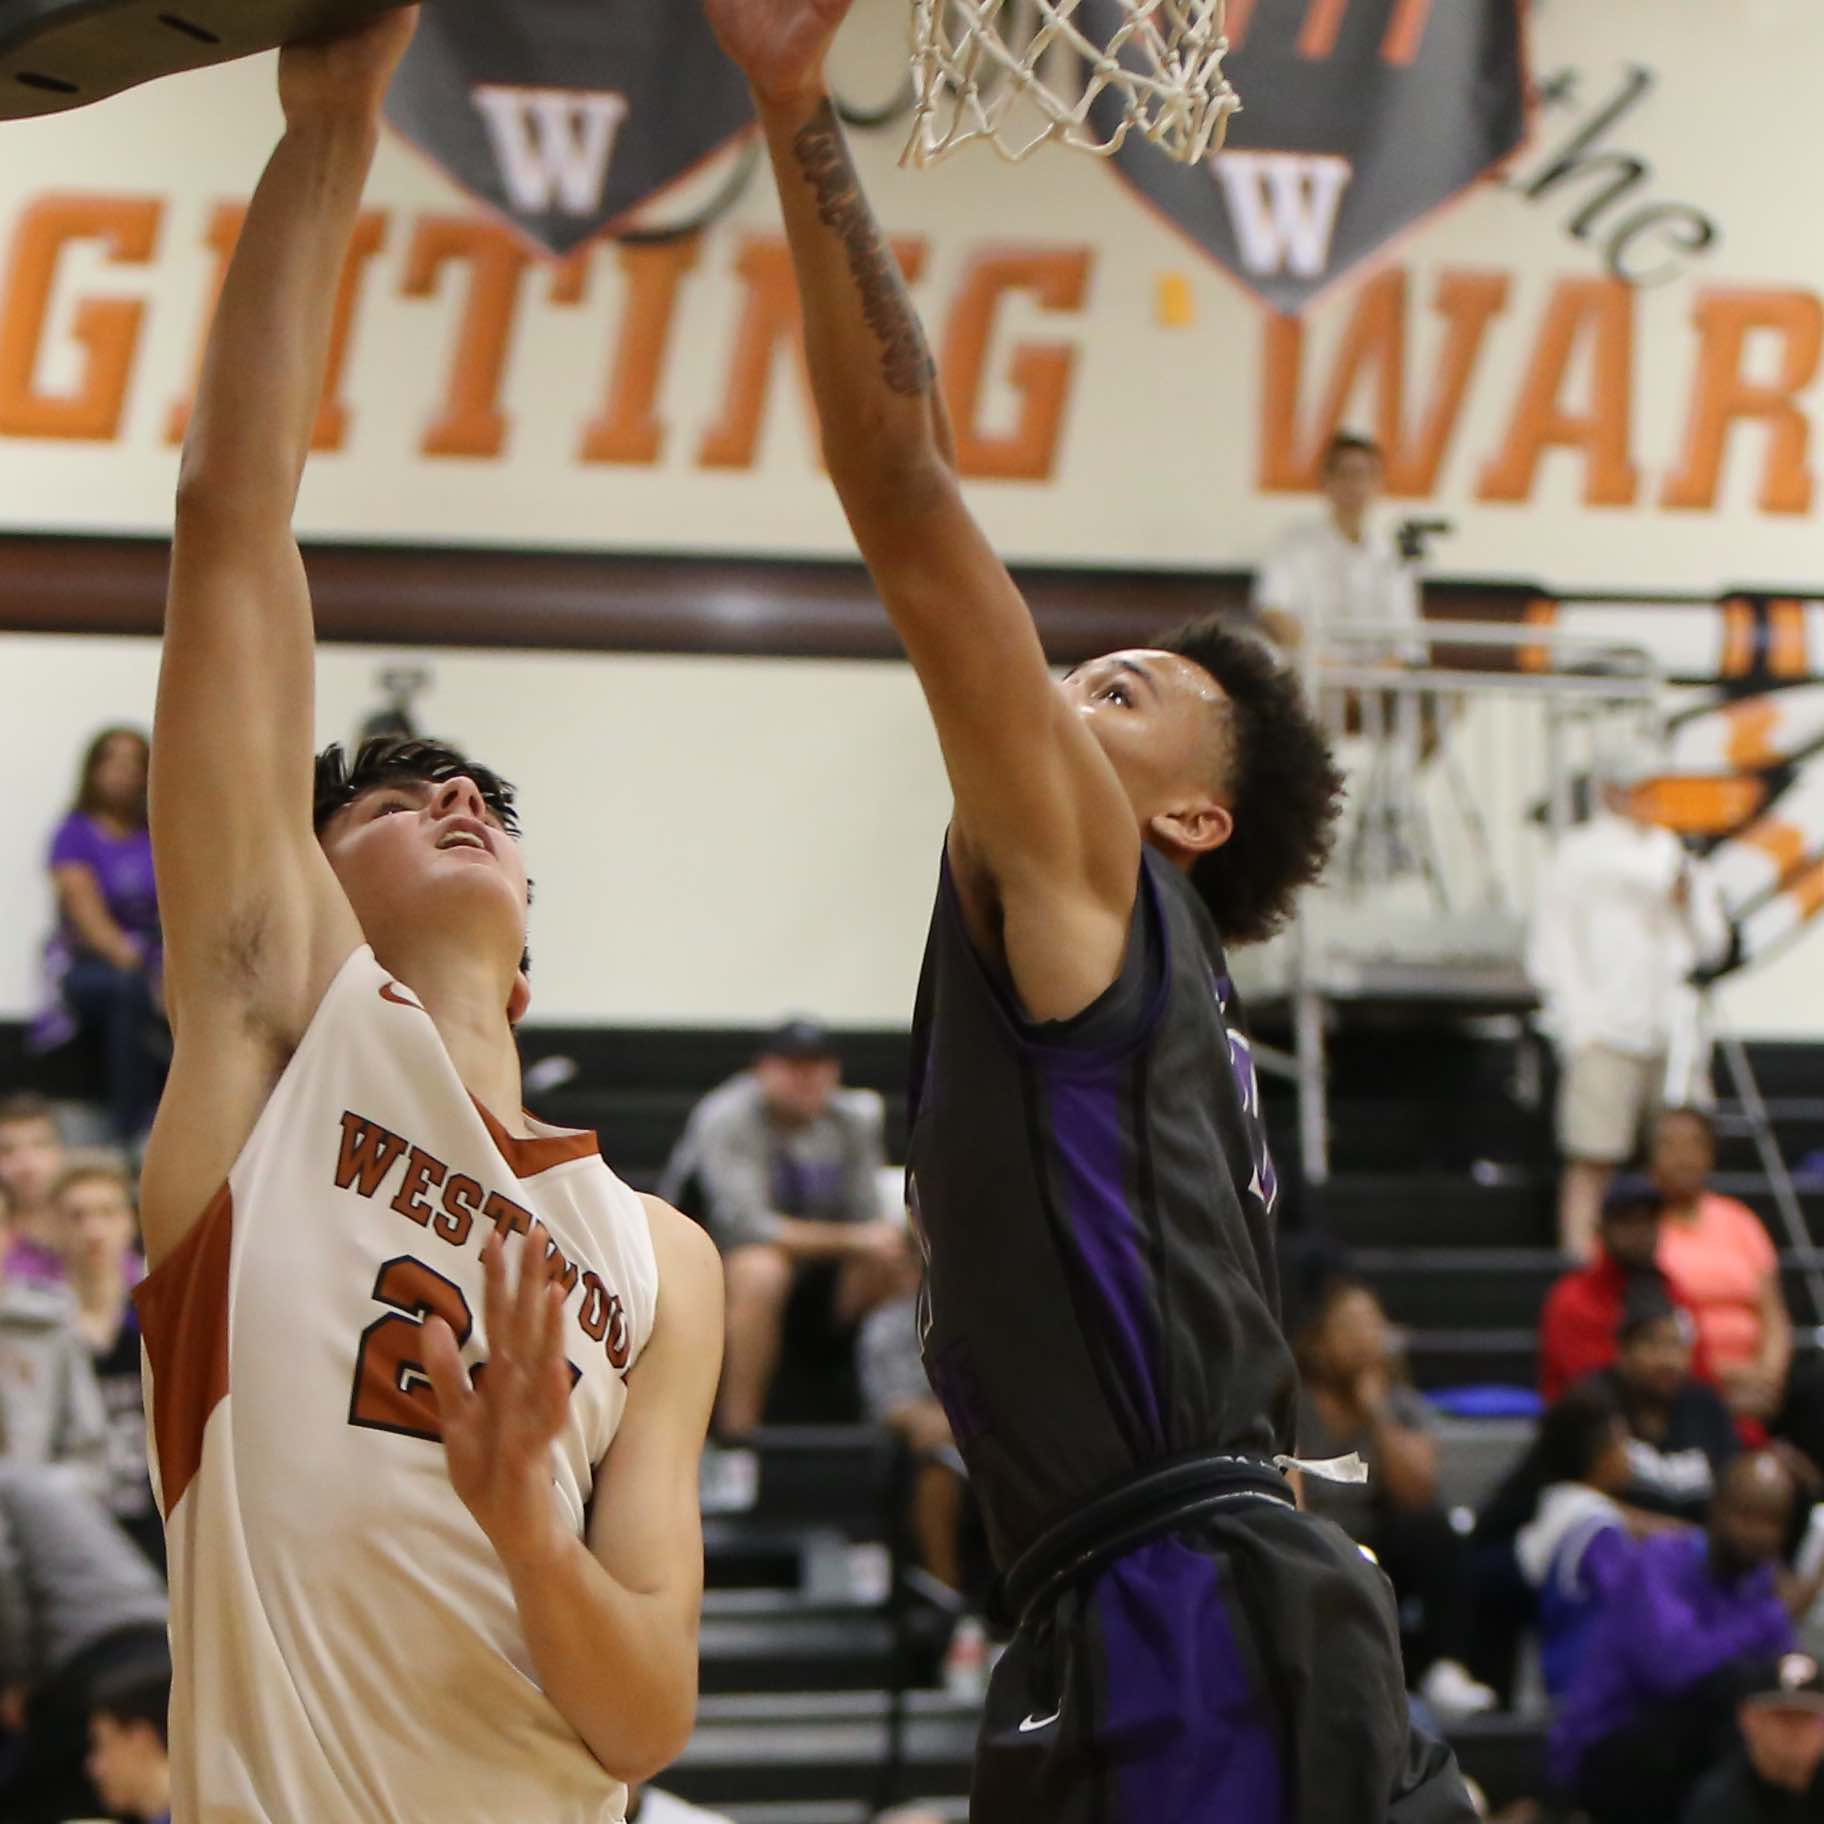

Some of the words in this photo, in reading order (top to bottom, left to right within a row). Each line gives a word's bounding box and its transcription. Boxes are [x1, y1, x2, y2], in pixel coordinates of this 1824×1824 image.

[469, 82, 630, 216] W
[1212, 148, 1353, 280] W
[347, 1254, 583, 1443] 2
